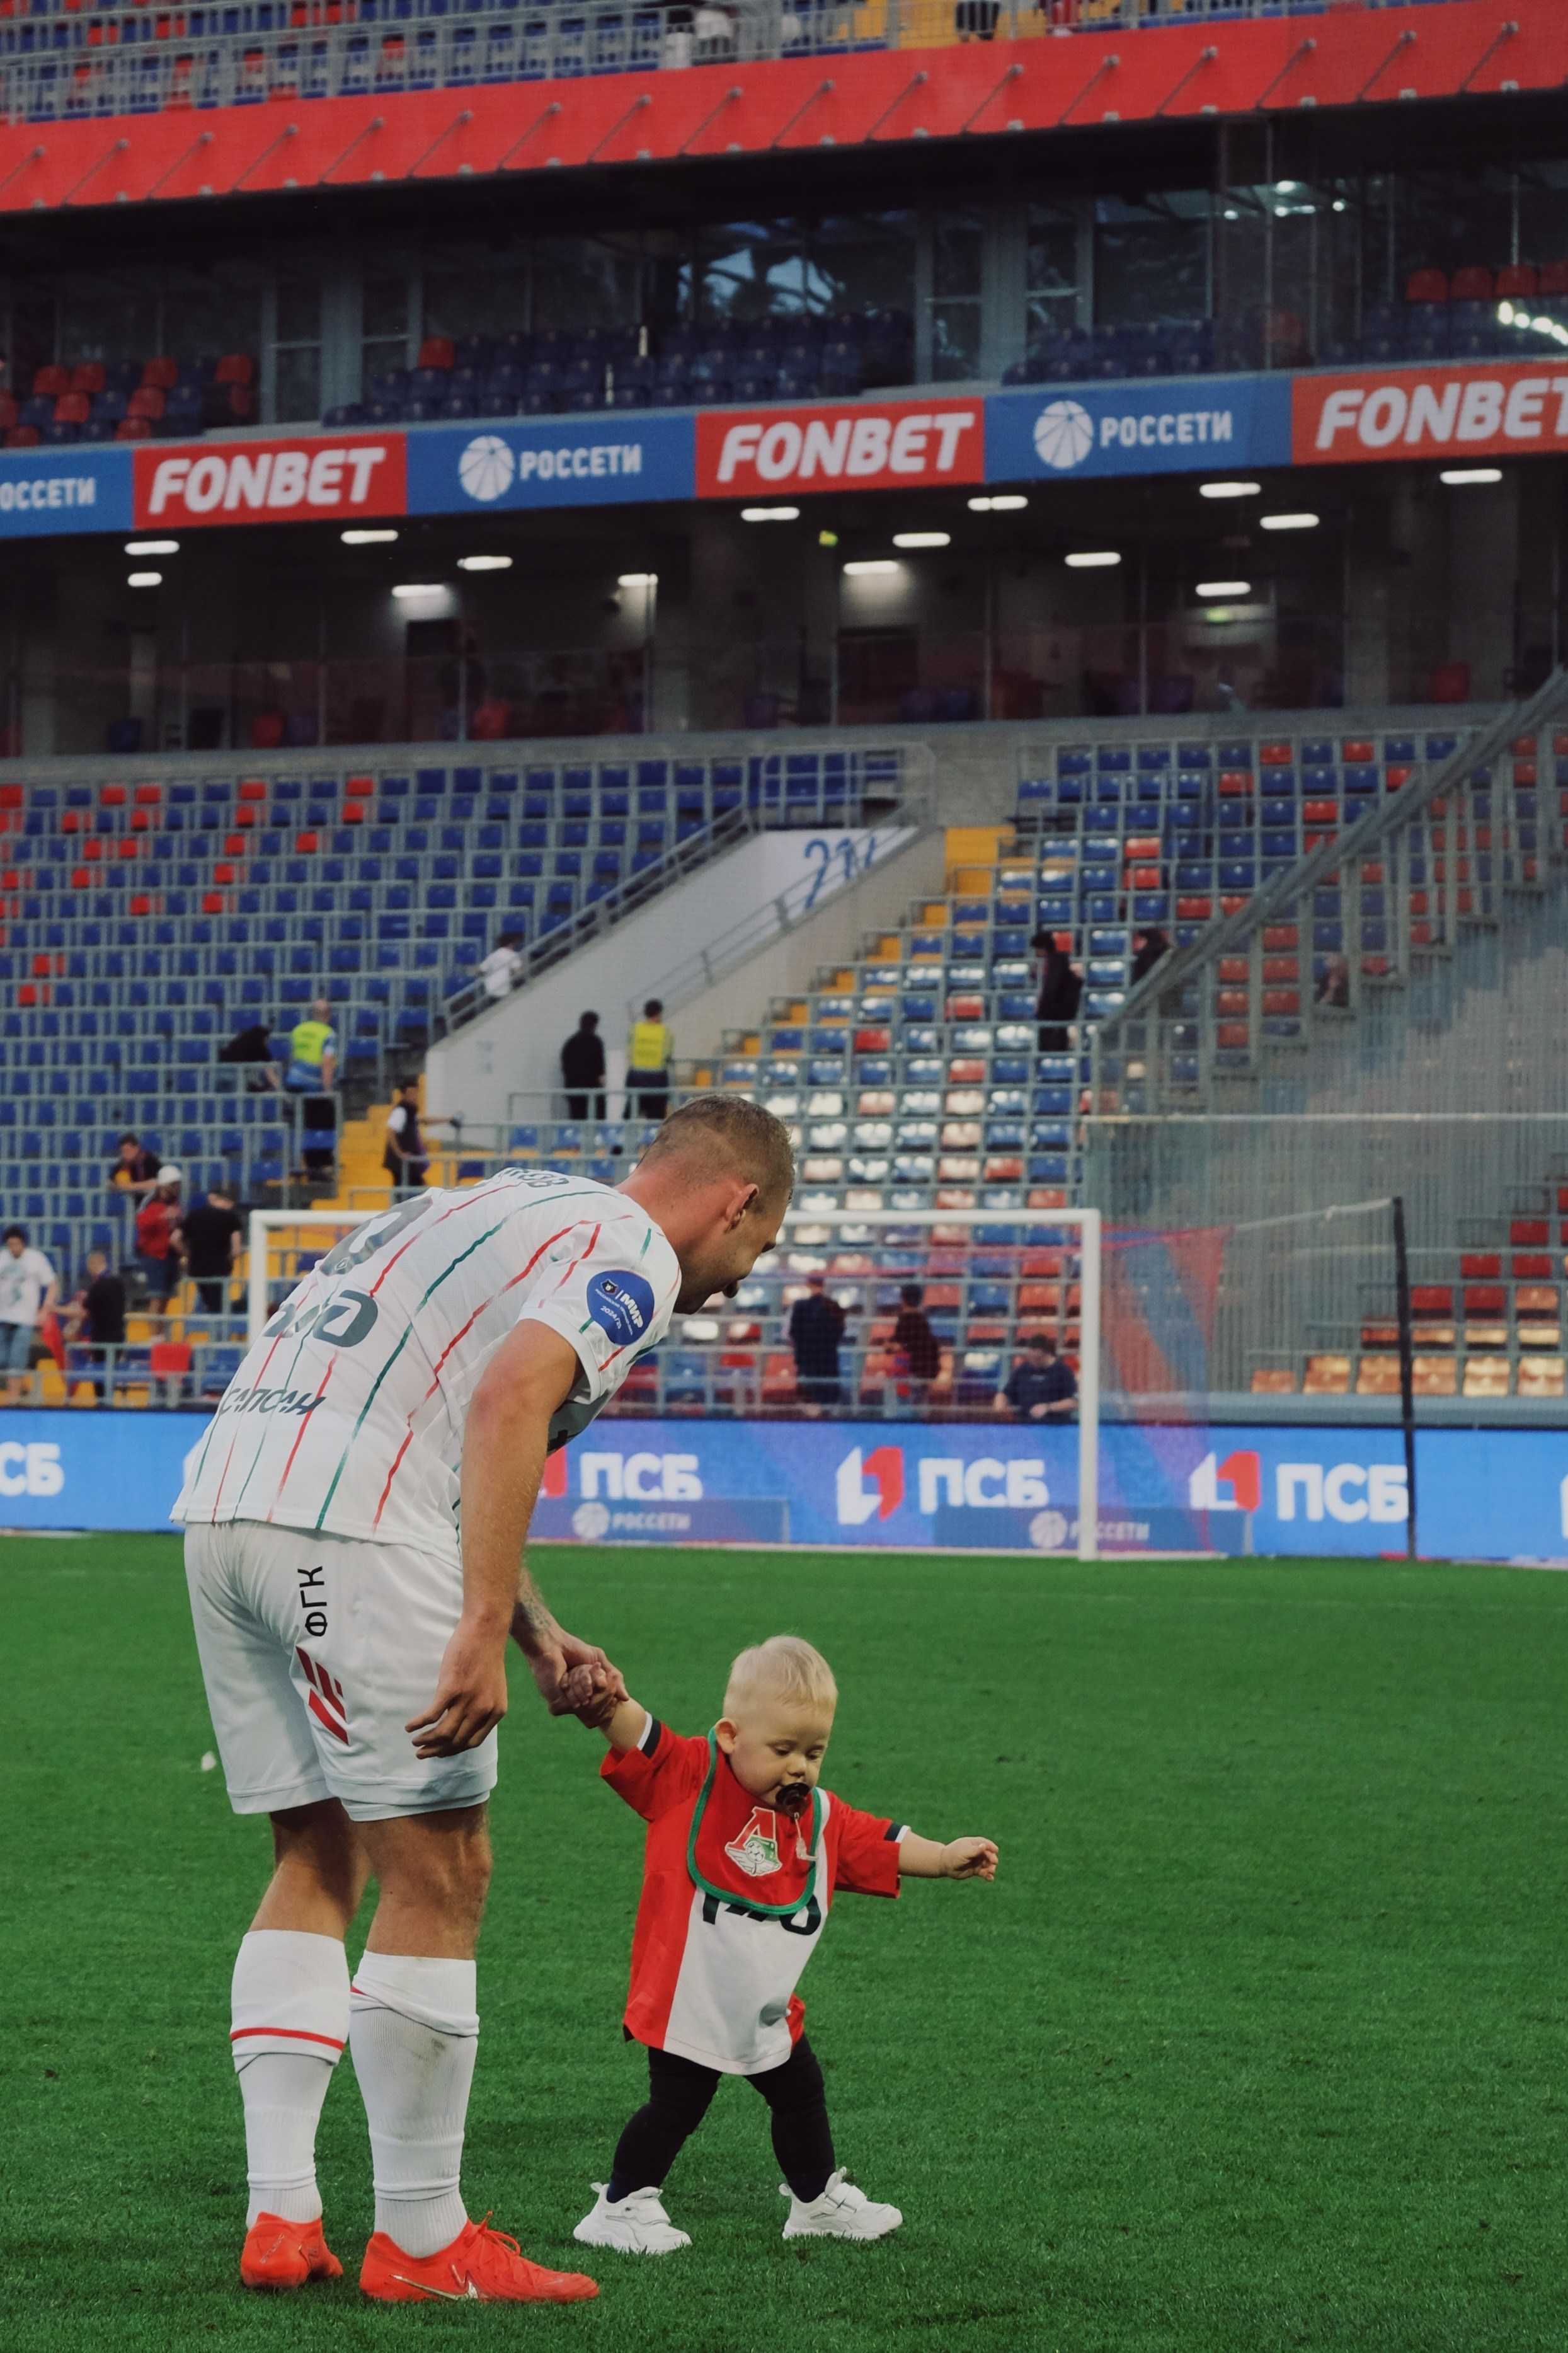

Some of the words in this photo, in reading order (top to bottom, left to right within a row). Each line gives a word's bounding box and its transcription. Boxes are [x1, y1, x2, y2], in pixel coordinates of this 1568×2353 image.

[717, 411, 975, 482] FONBET
[1100, 411, 1233, 447] РОССЕТИ
[148, 447, 386, 514] FONBET
[519, 444, 642, 480] РОССЕТИ
[0, 477, 96, 512] ОССЕТИ
[620, 1292, 643, 1328] МИР
[219, 1388, 327, 1416] САПСАН
[0, 1441, 64, 1497] СБ
[580, 1452, 704, 1502] ПСБ
[918, 1458, 1050, 1514] ПСБ
[1276, 1463, 1409, 1523] ПСБ
[611, 1512, 691, 1531] РОССЕТИ
[297, 1566, 328, 1637] ФГК
